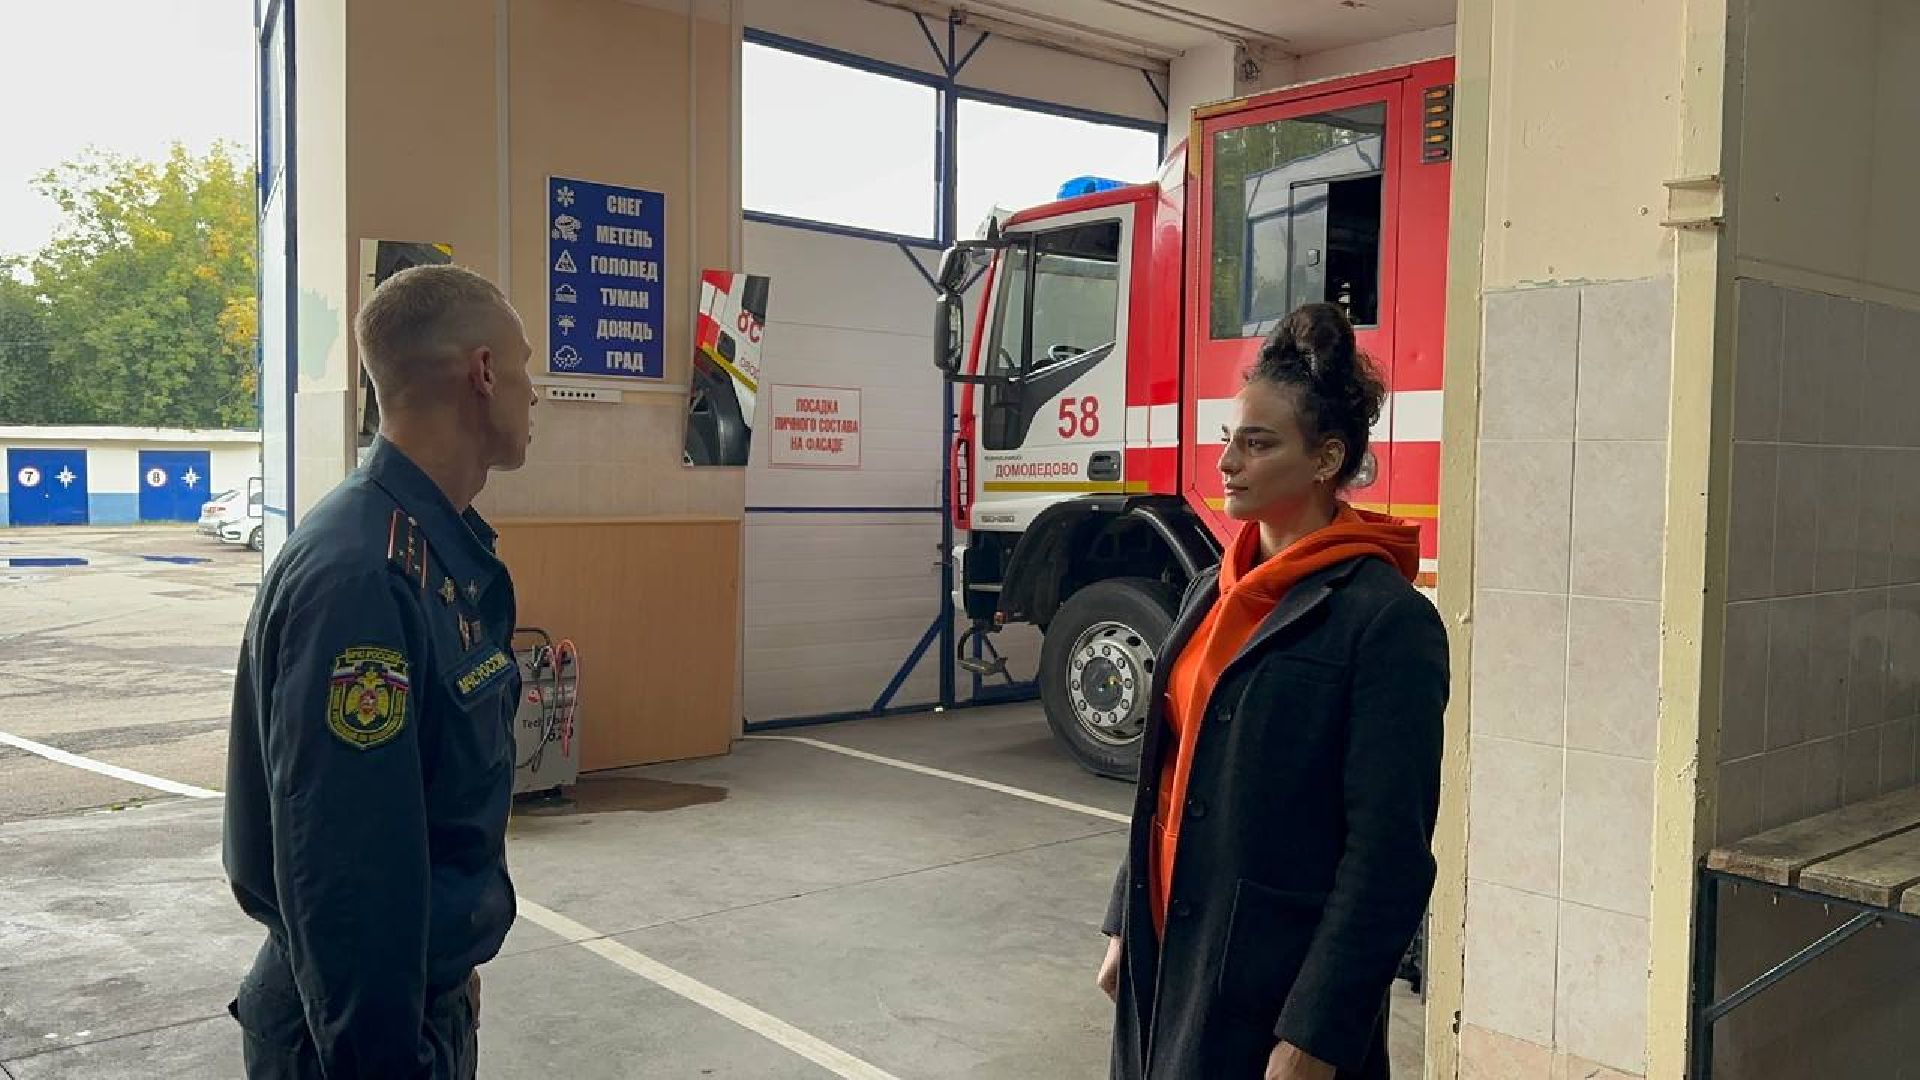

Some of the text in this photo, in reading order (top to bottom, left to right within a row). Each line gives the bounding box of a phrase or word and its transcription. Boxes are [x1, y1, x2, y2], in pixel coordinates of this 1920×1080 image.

[606, 194, 643, 217] СНЕГ
[596, 224, 653, 248] МЕТЕЛЬ
[590, 255, 659, 283] ГОЛОЛЕД
[600, 287, 649, 310] ТУМАН
[596, 318, 653, 342] ДОЖДЬ
[606, 350, 644, 373] ГРАД
[796, 398, 839, 415] ПОСАДКА
[1057, 395, 1100, 439] 58
[819, 419, 859, 433] СОСТАВА
[791, 436, 844, 453] НА ФАСАДЕ
[24, 471, 34, 482] 7
[152, 471, 160, 483] 8
[995, 461, 1079, 479] ДОМОДЕДОВО
